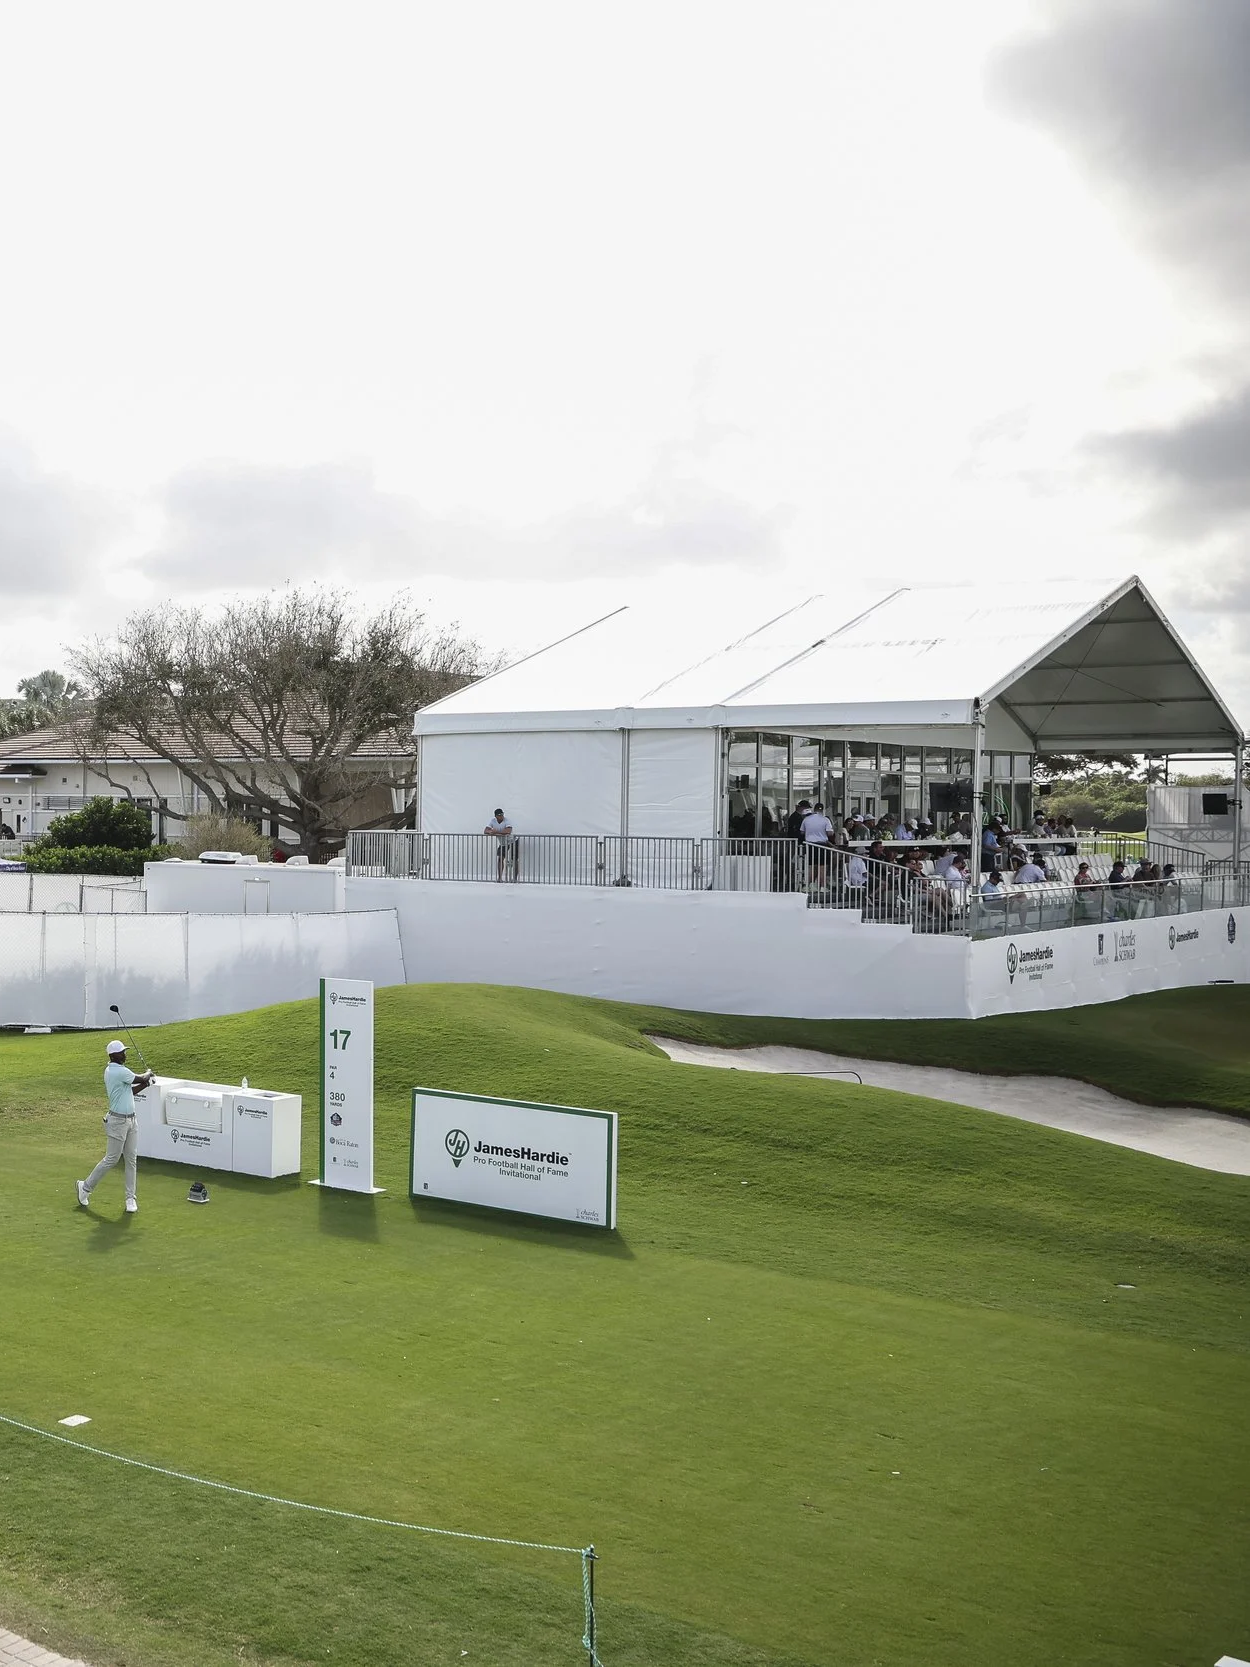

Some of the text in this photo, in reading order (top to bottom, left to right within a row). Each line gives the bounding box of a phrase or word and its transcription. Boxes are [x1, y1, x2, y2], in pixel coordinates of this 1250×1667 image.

[1019, 946, 1053, 962] JamesHardie
[330, 1029, 351, 1050] 17
[330, 1071, 335, 1079] 4
[329, 1091, 346, 1102] 380
[180, 1133, 211, 1142] JamesHardie
[474, 1140, 569, 1166] JamesHardie
[473, 1156, 569, 1178] Pro Football Hall of Fame
[499, 1168, 542, 1181] Invitational
